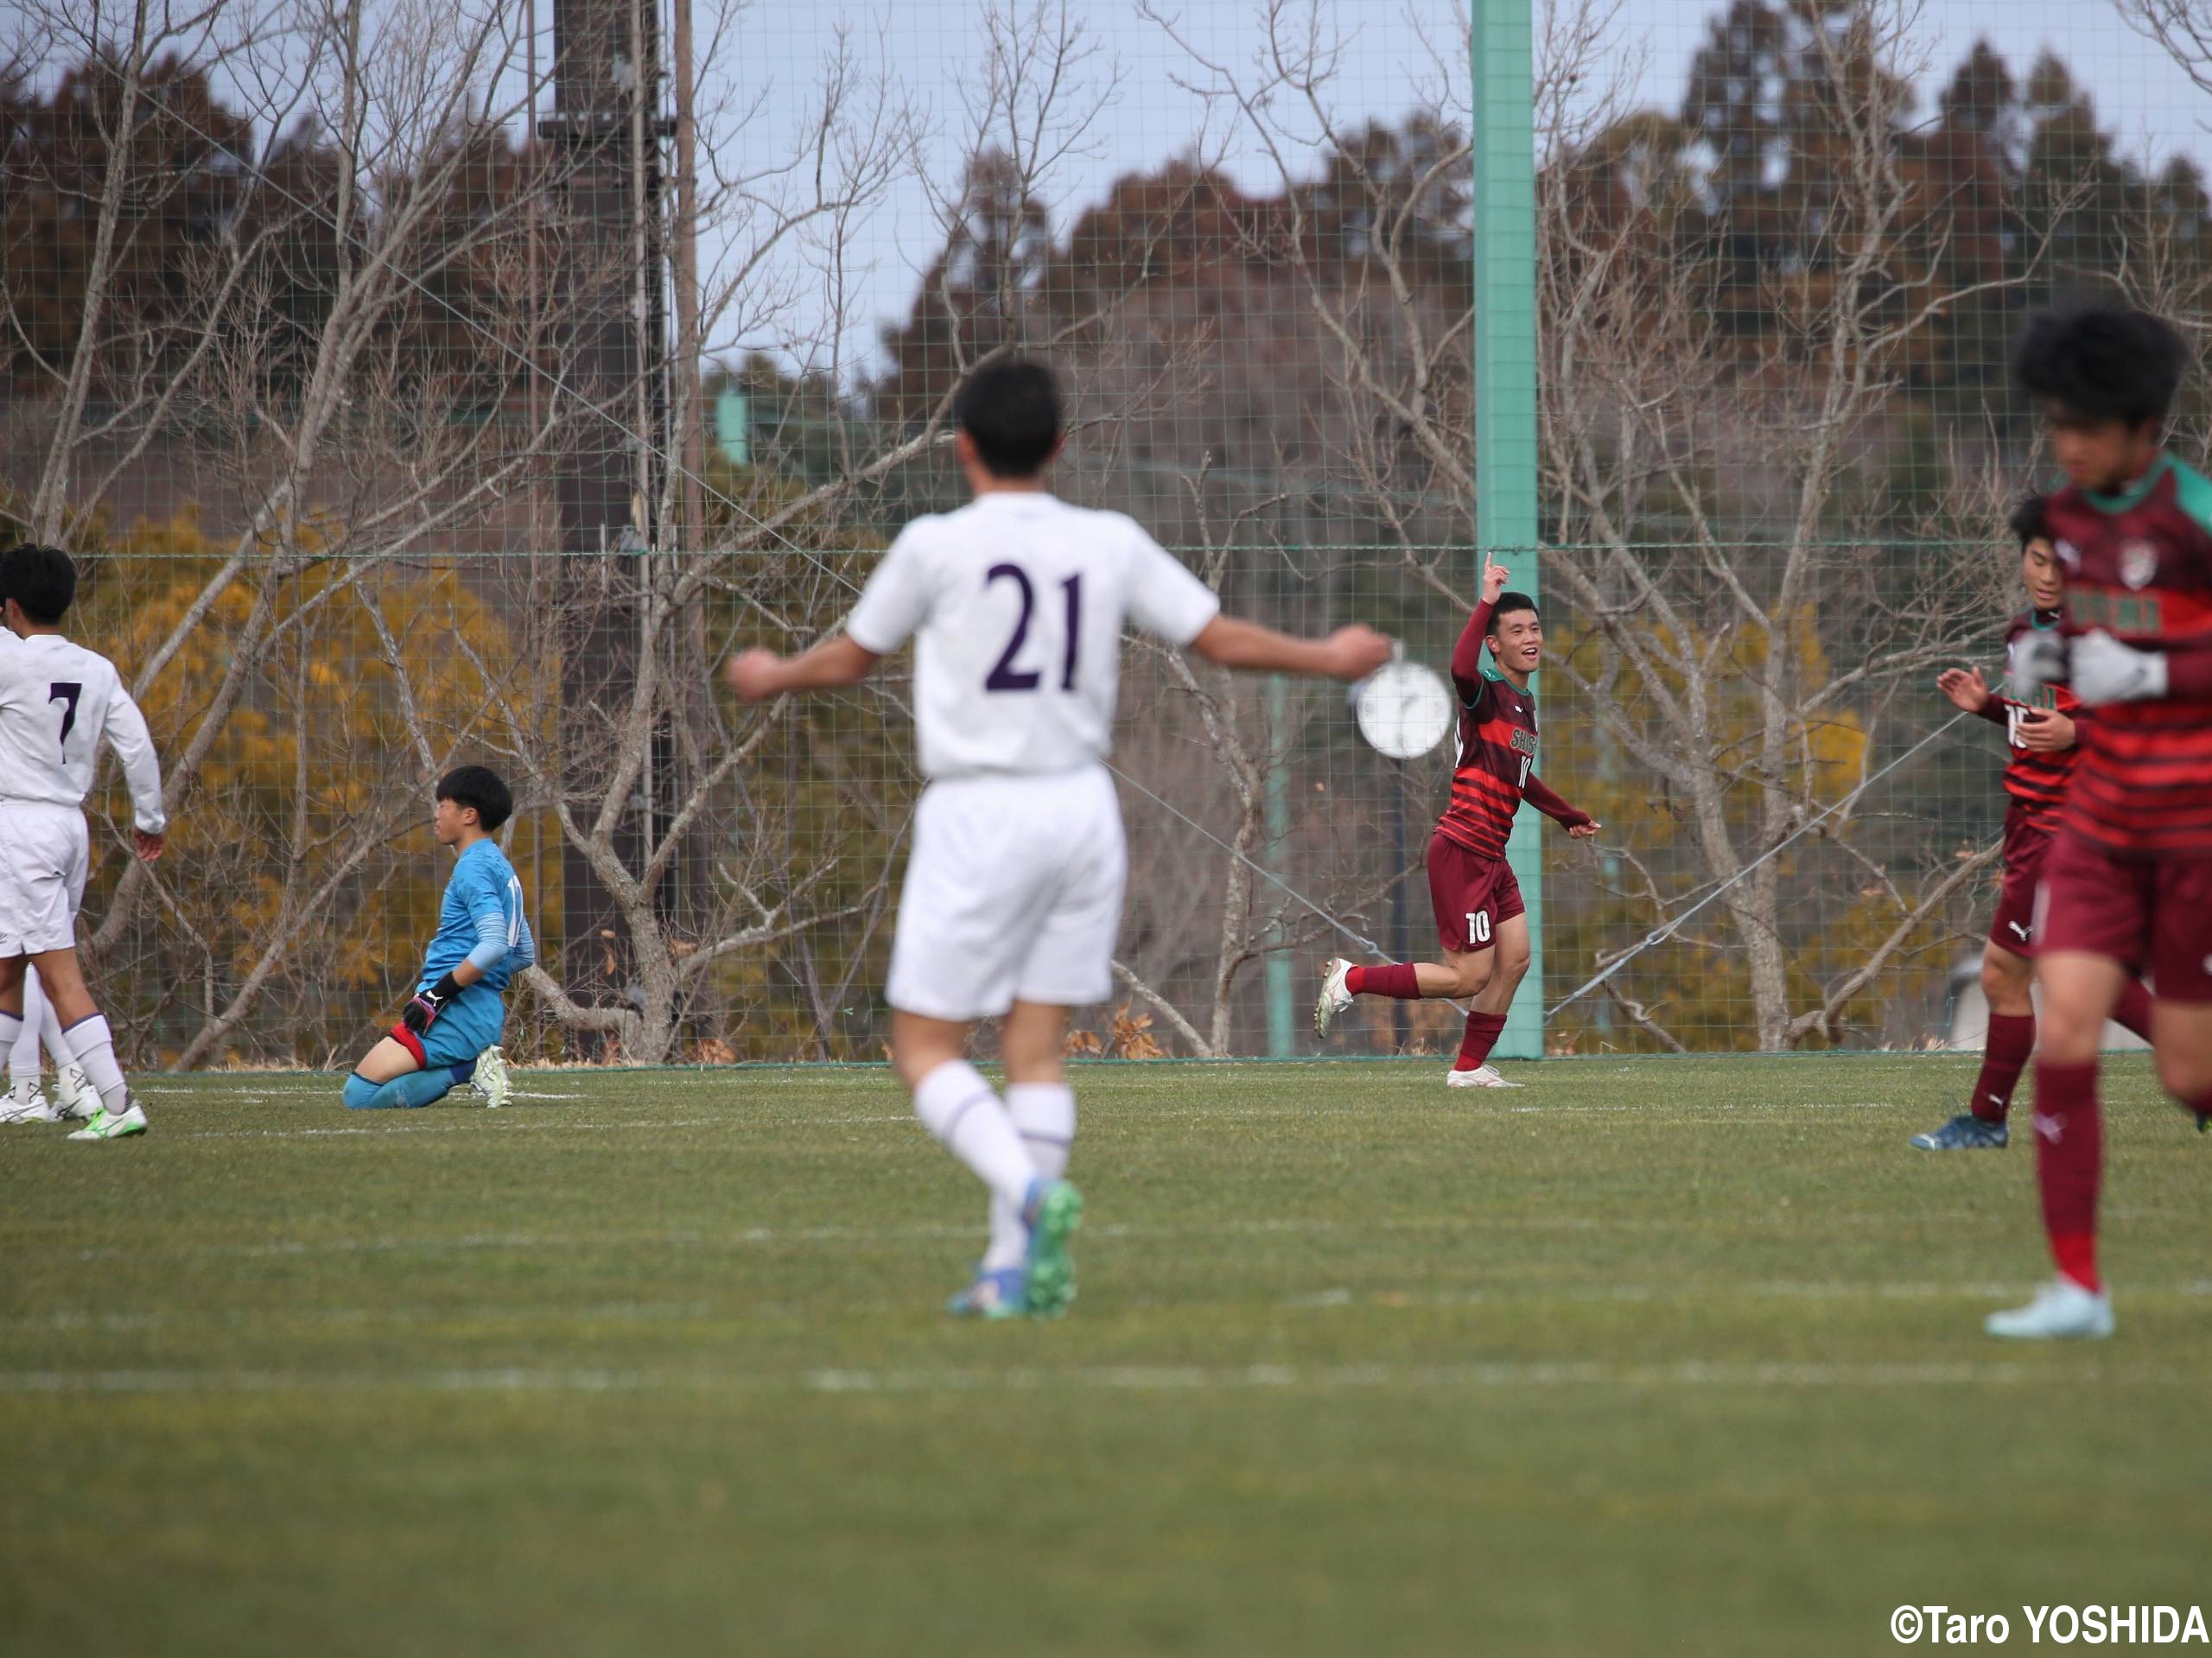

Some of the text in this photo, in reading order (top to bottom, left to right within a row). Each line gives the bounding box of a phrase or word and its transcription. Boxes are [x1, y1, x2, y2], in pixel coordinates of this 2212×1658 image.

[985, 563, 1082, 692] 21
[48, 683, 82, 765] 7
[1465, 910, 1491, 944] 10
